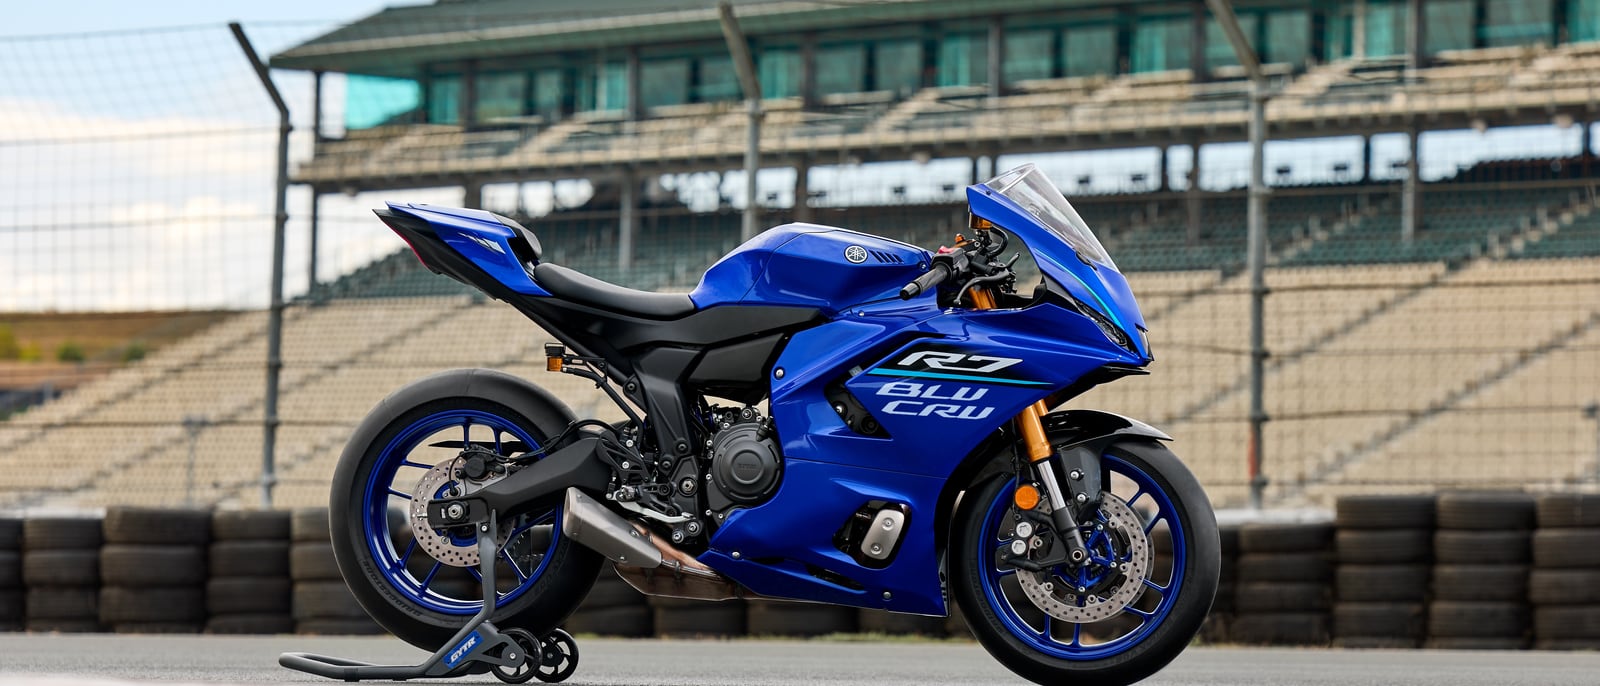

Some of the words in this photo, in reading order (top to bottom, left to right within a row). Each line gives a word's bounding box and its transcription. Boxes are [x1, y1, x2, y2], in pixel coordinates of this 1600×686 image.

[897, 350, 1023, 373] R7
[875, 381, 989, 401] BLU
[880, 400, 996, 420] CRU
[450, 636, 477, 663] GYTR
